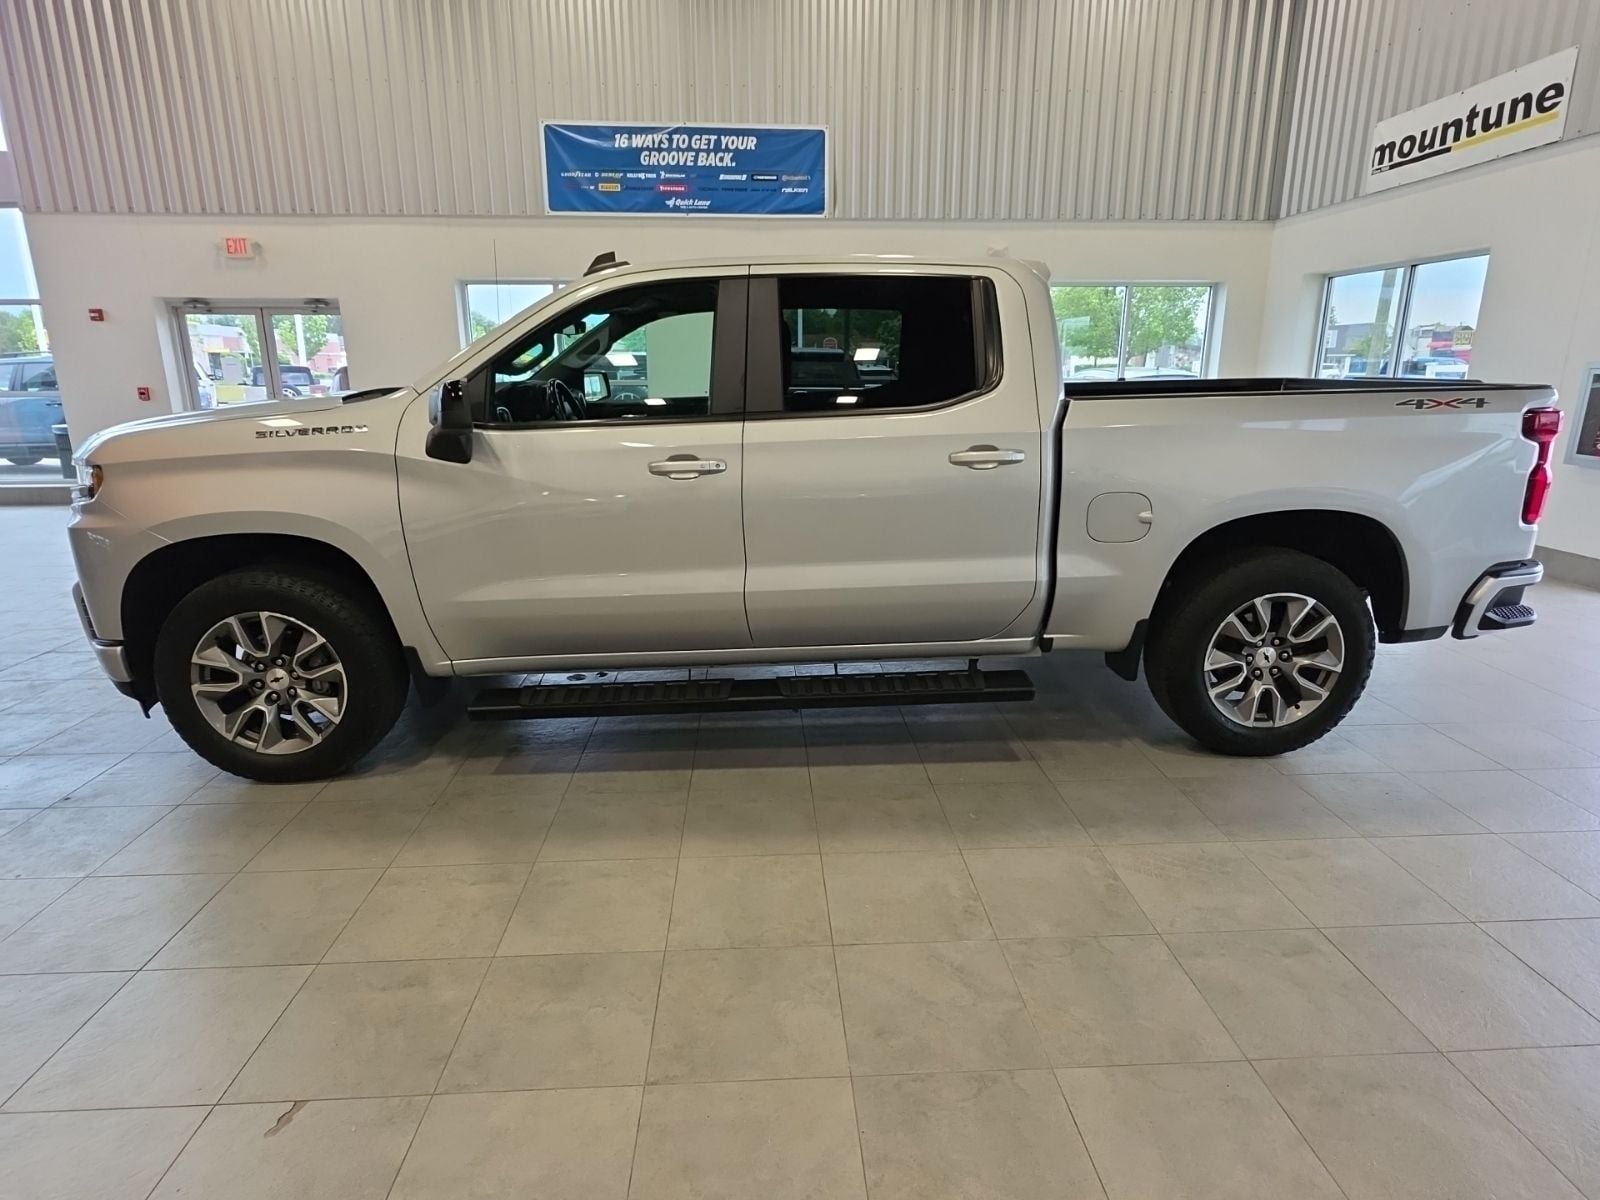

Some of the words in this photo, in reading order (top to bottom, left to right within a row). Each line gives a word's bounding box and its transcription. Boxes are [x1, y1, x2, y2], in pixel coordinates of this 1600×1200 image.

[1371, 82, 1564, 169] mountune
[614, 133, 629, 148] 16
[631, 134, 669, 148] WAYS
[672, 134, 689, 148] TO
[691, 135, 718, 149] GET
[720, 135, 757, 150] YOUR
[640, 151, 696, 166] GROOVE
[697, 152, 736, 167] BACK.
[675, 198, 694, 206] Quick
[225, 237, 248, 255] EXIT
